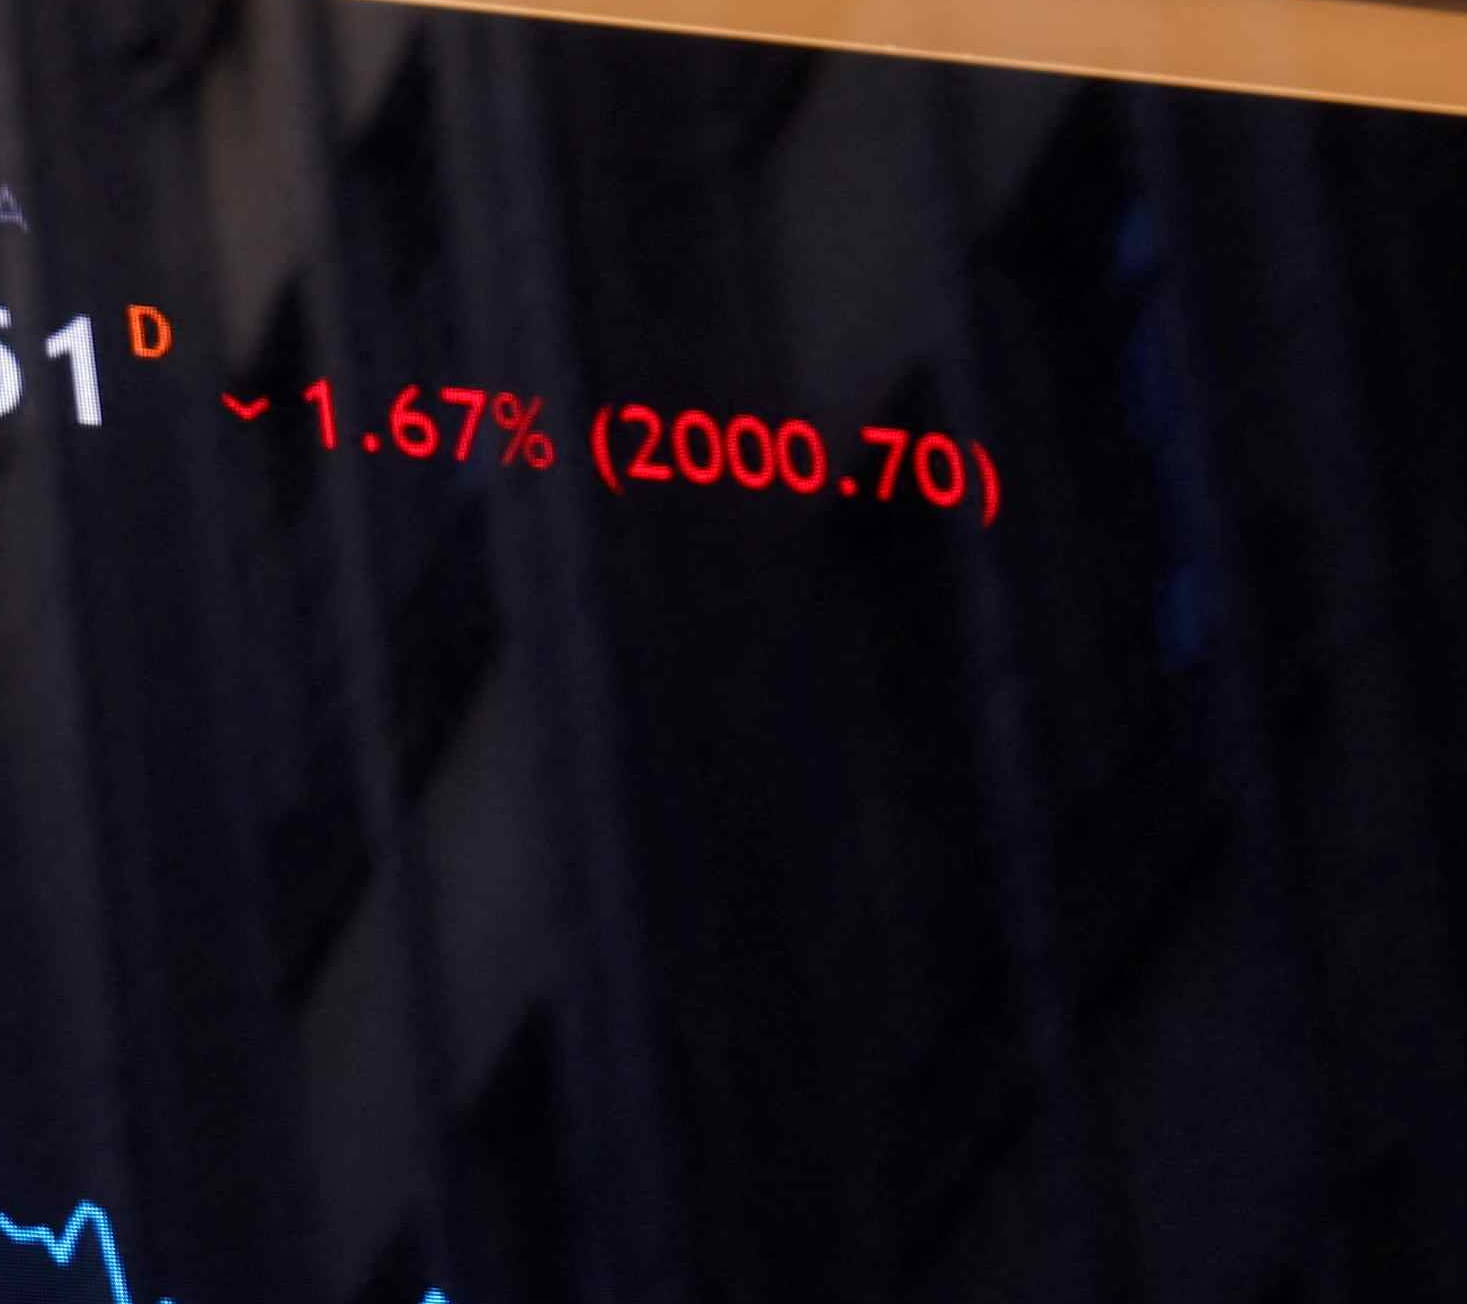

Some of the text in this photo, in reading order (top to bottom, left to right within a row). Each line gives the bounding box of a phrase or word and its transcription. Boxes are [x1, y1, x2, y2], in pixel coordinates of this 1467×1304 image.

[125, 304, 172, 361] D
[302, 377, 556, 470] 1.67%
[590, 403, 1000, 529] (2000.70)
